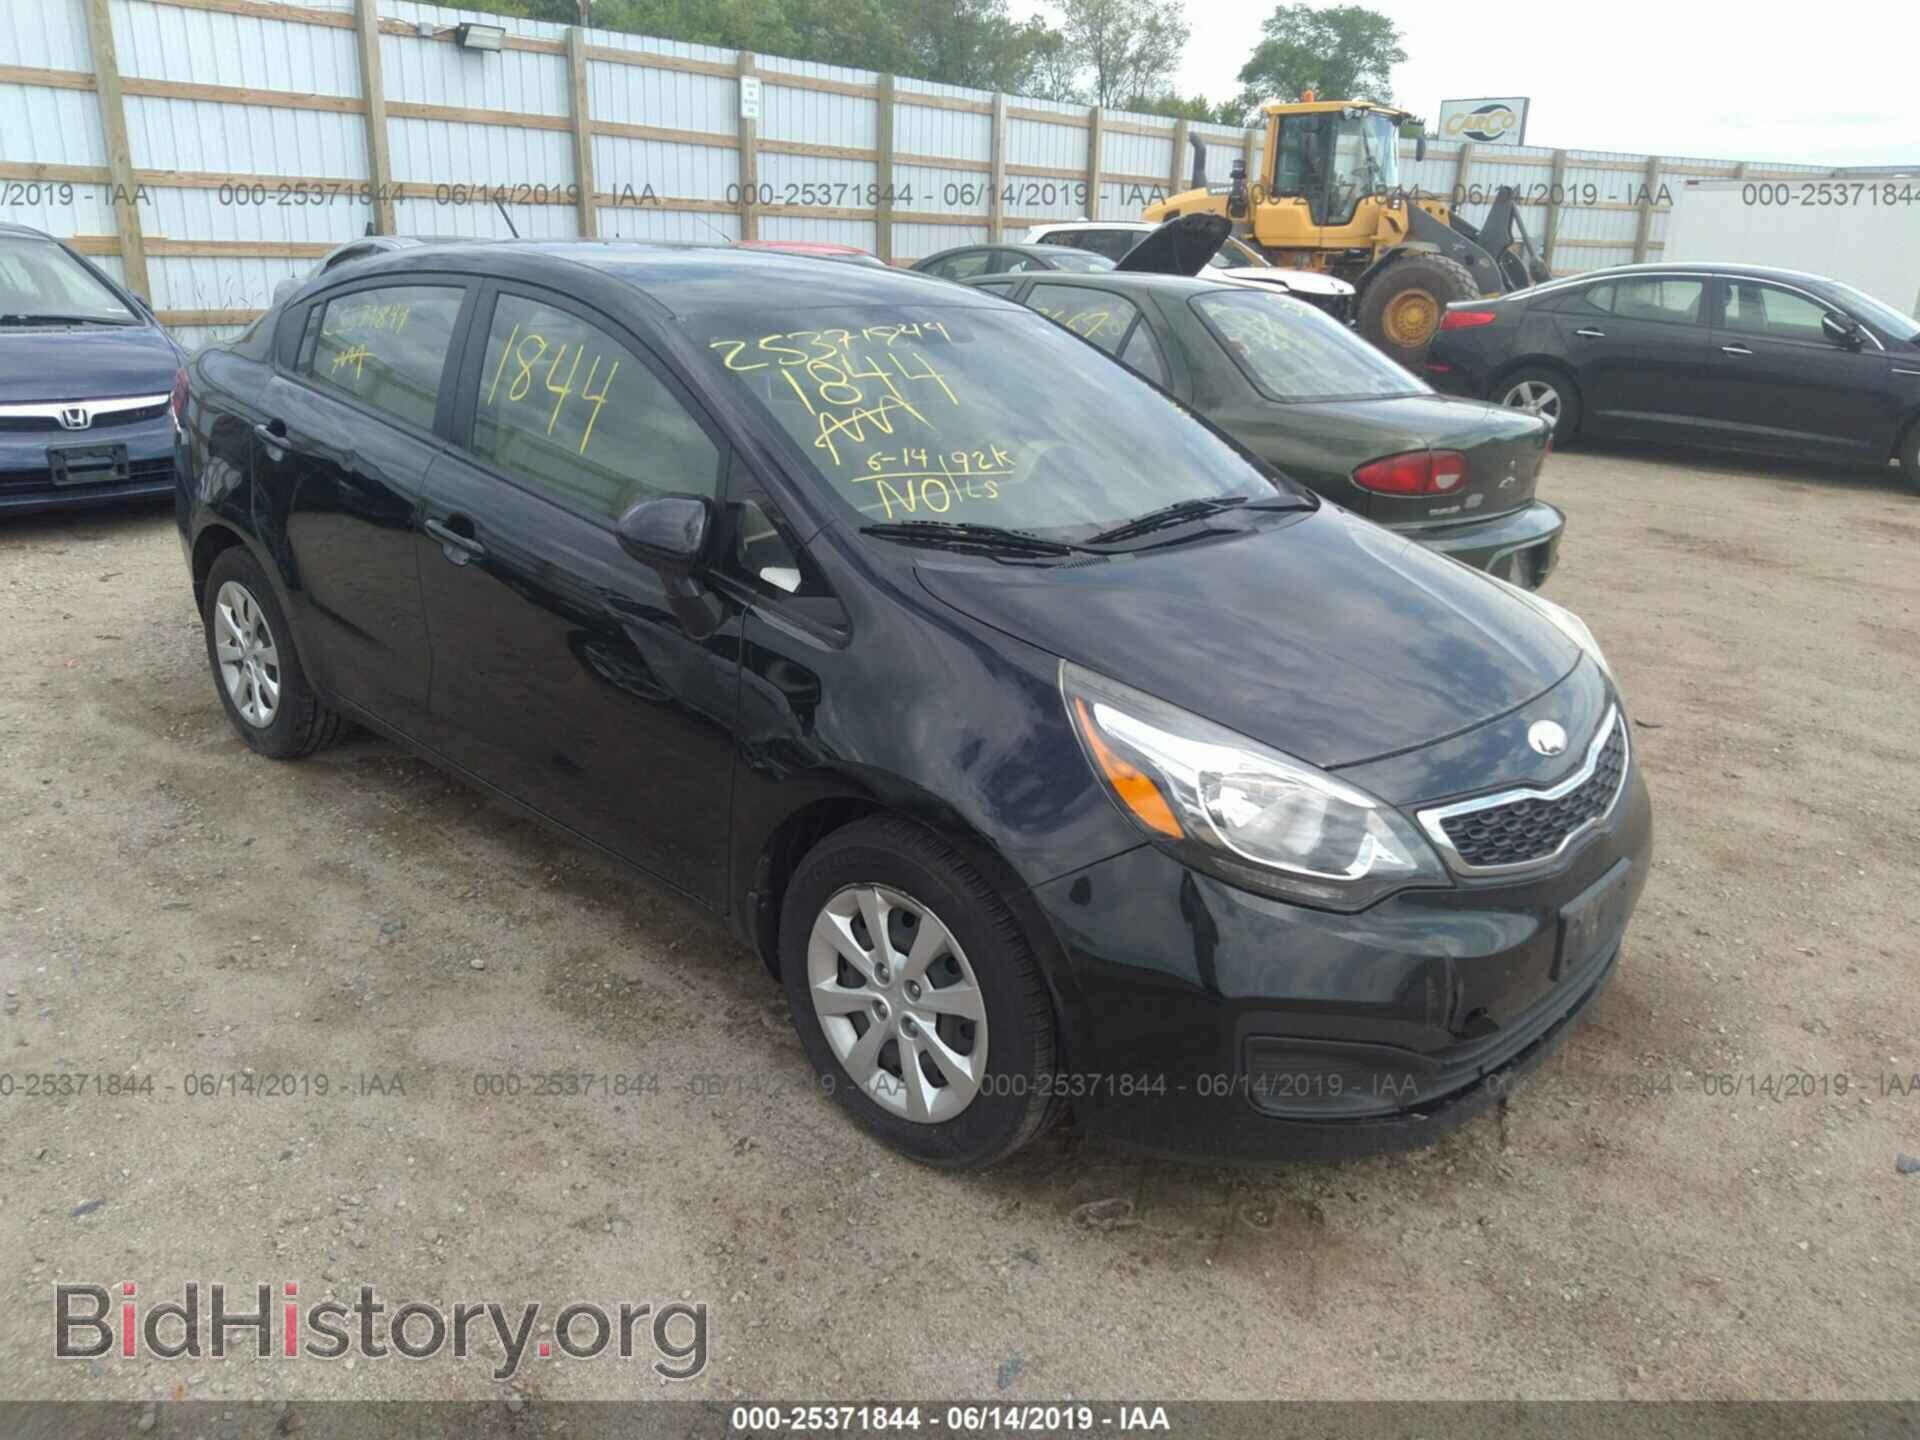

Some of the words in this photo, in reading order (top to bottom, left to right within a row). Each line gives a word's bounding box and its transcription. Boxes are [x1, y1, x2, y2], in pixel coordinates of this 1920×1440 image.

[487, 323, 620, 456] 1844
[781, 352, 959, 416] 1844
[866, 448, 929, 472] 6-14
[876, 478, 951, 520] NO
